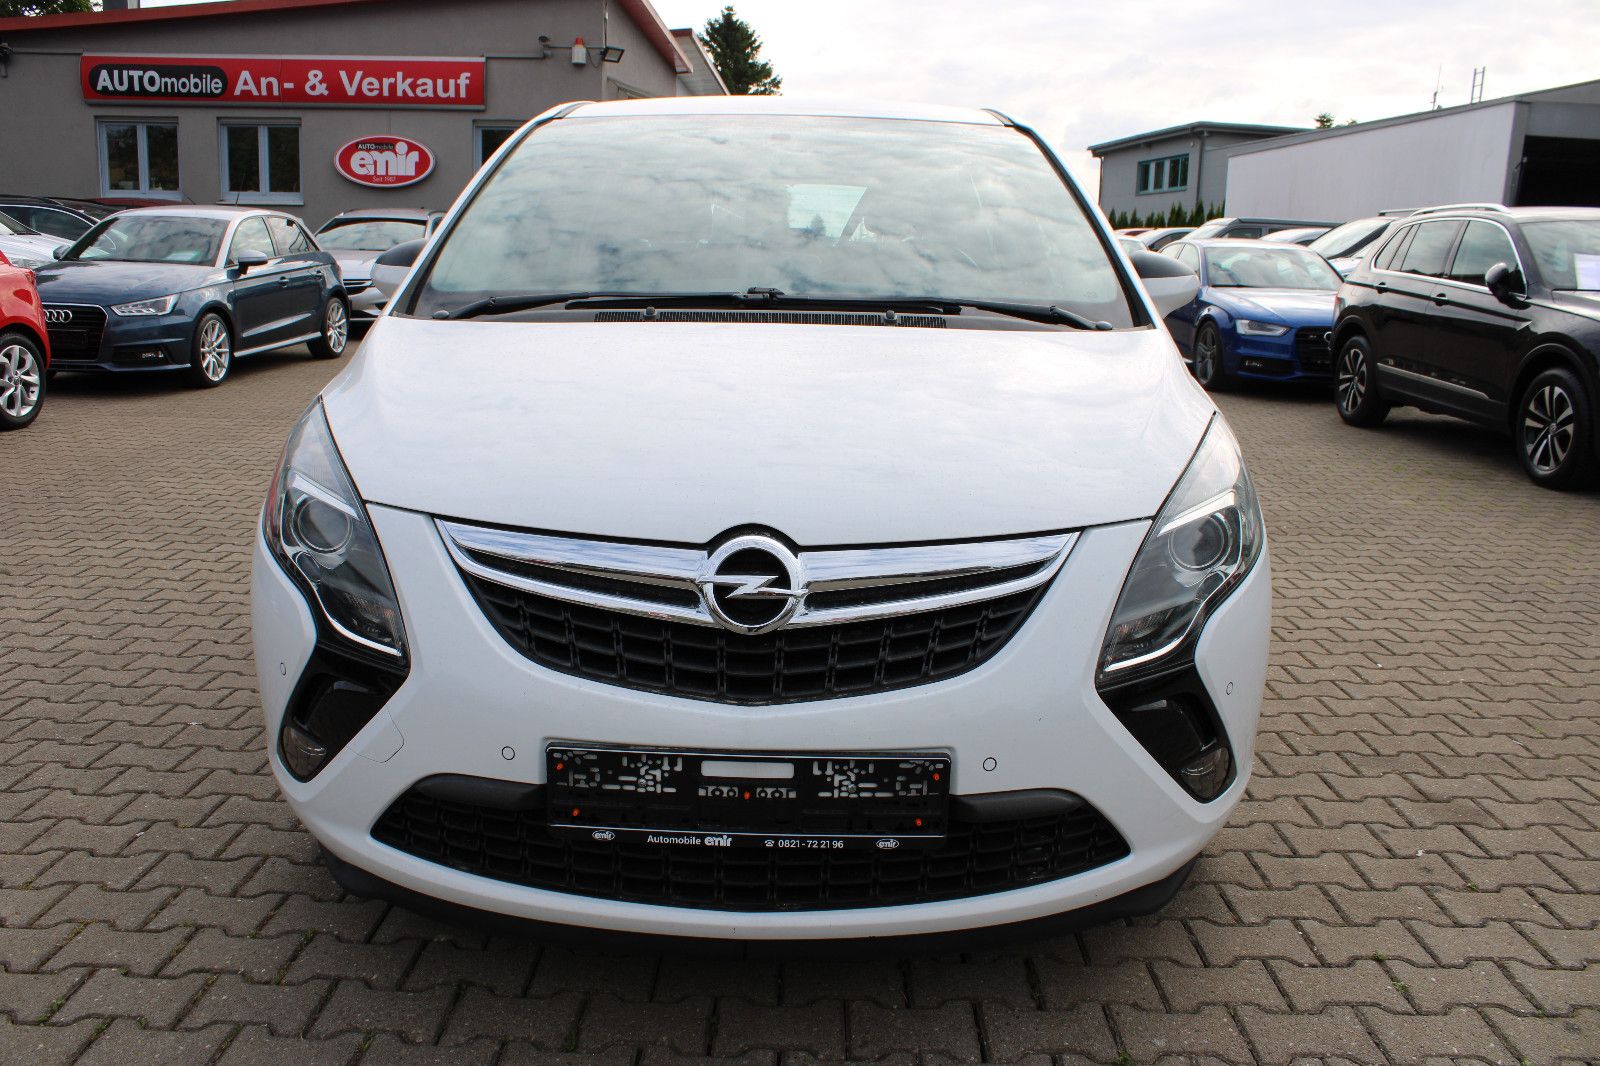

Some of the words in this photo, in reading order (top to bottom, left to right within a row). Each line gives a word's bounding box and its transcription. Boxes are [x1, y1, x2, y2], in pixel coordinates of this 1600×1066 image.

[96, 69, 223, 94] AUTOmobile
[234, 70, 295, 96] An-
[304, 69, 329, 96] &
[338, 70, 471, 98] Verkauf
[350, 141, 419, 175] emir
[594, 830, 613, 840] emir
[647, 834, 702, 845] Automobile
[704, 834, 733, 847] emir
